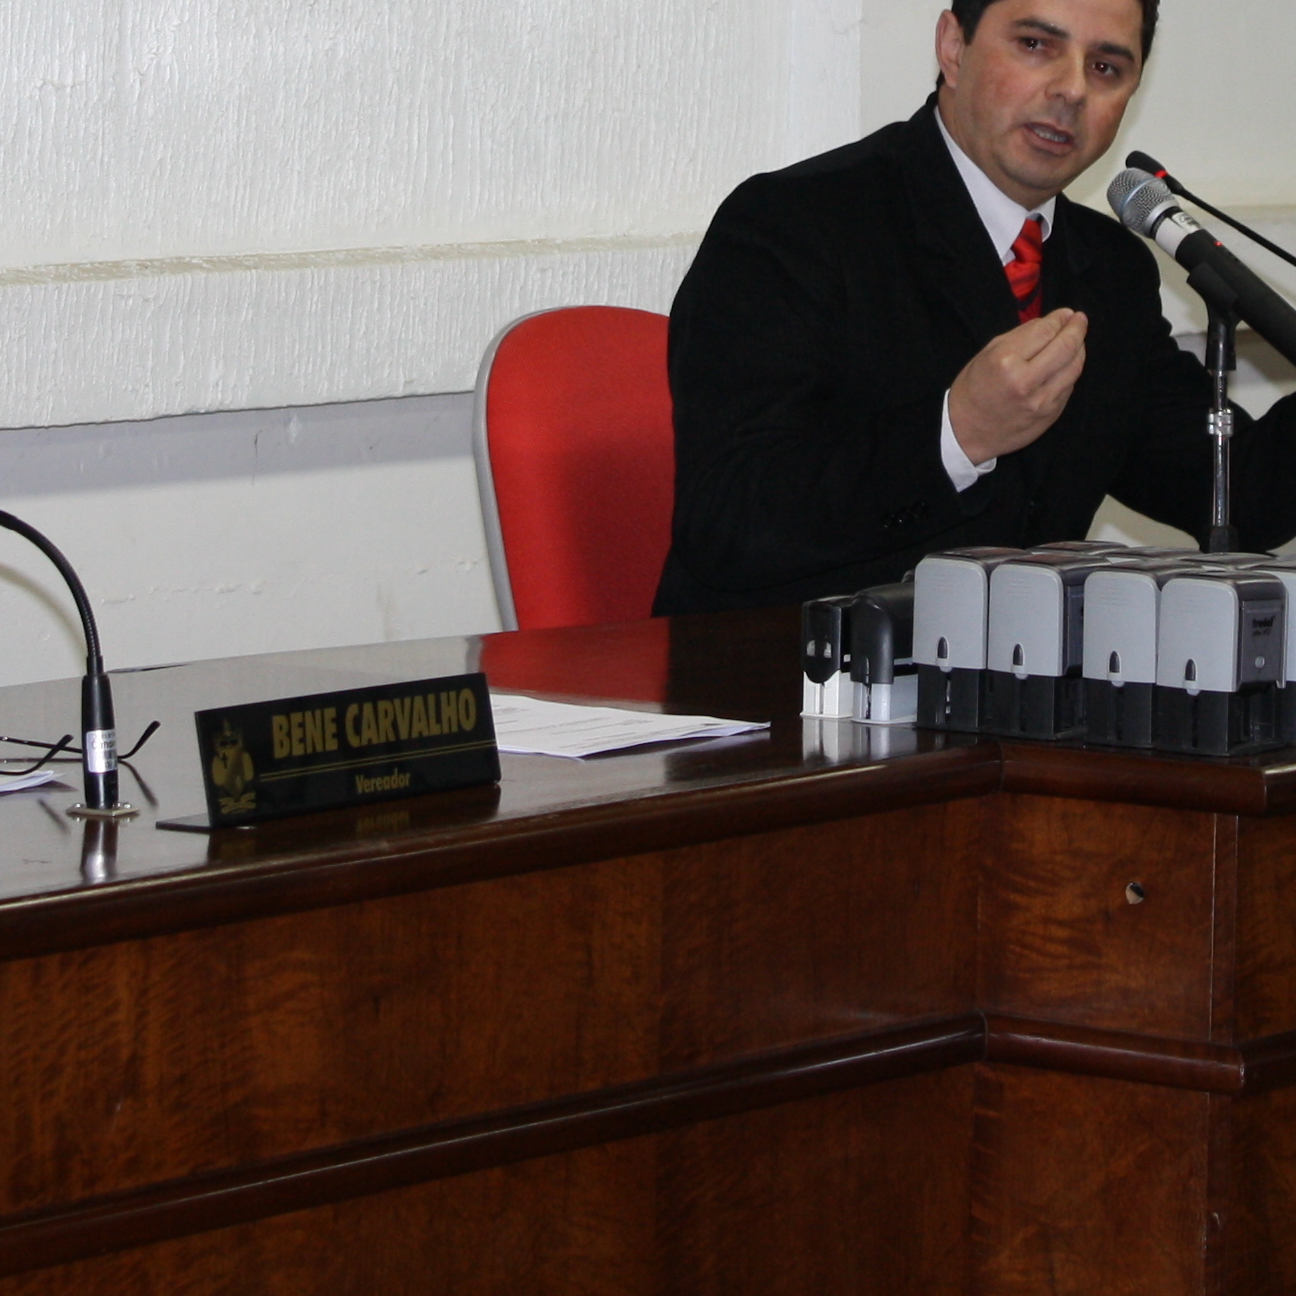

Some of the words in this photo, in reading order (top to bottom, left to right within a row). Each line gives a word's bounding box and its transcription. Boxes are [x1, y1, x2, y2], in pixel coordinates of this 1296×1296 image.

[272, 707, 338, 759] BENE
[345, 688, 477, 747] CARVALHO
[355, 767, 411, 794] Vereador
